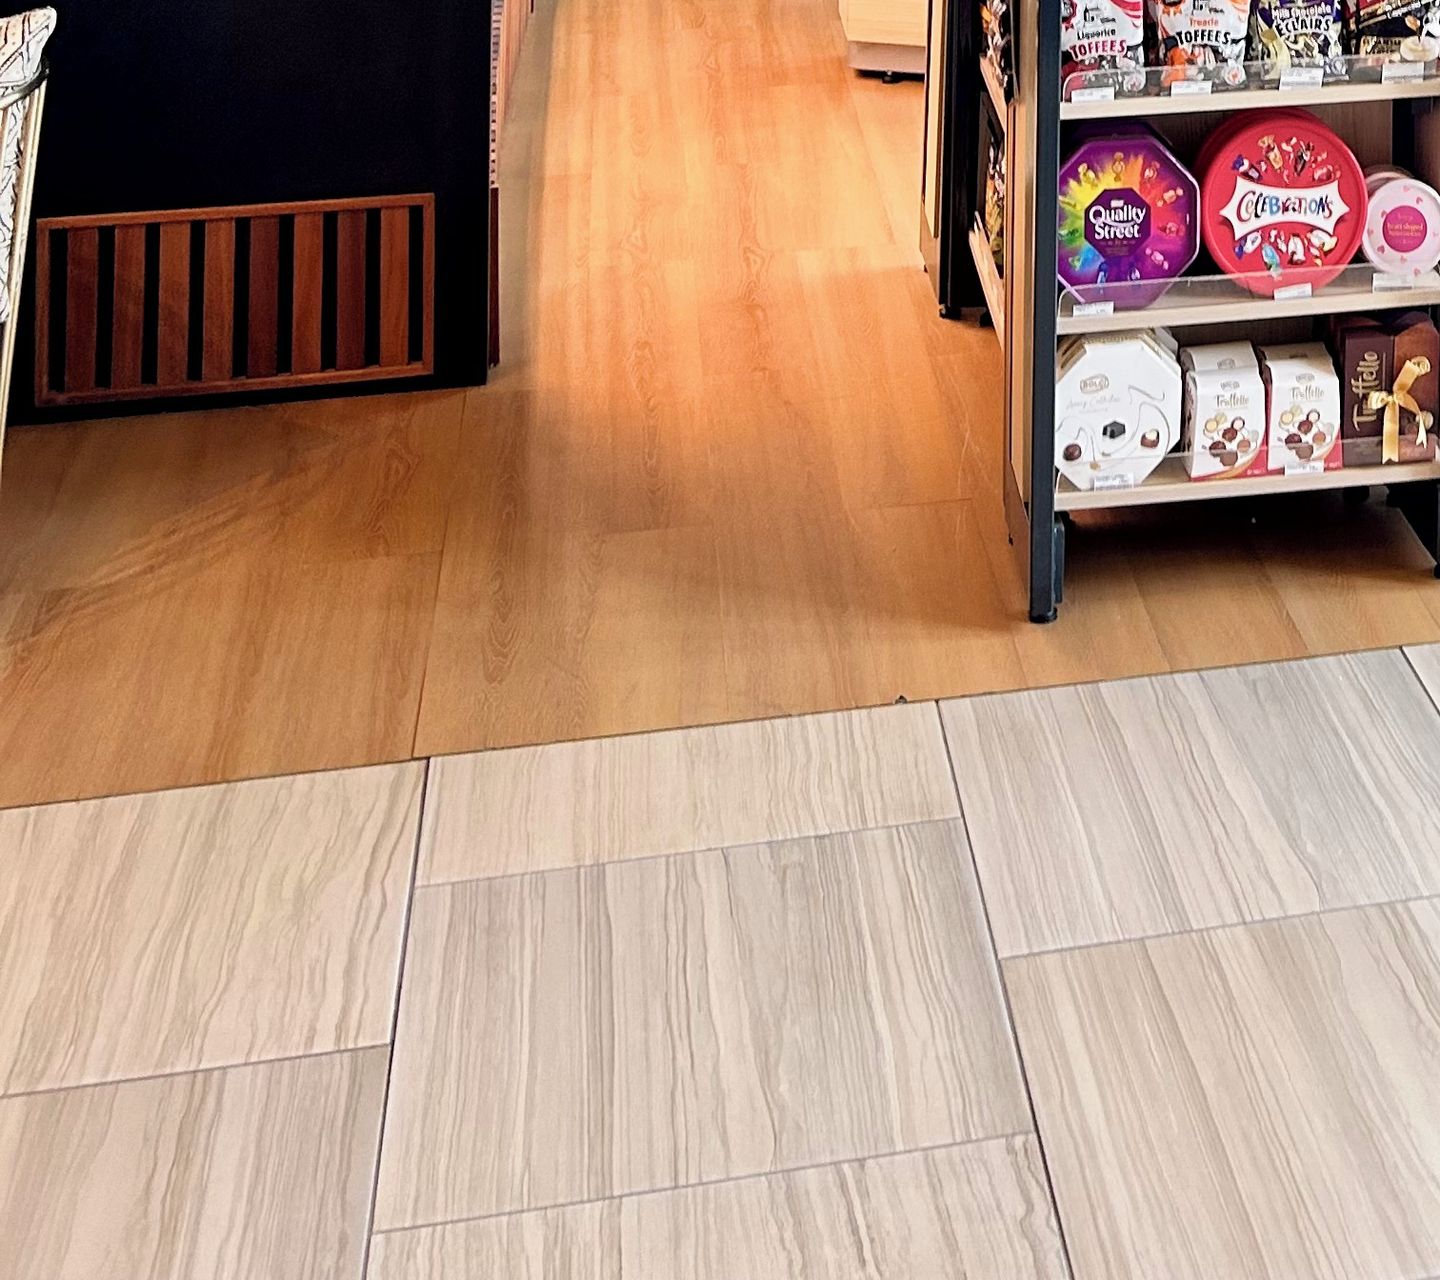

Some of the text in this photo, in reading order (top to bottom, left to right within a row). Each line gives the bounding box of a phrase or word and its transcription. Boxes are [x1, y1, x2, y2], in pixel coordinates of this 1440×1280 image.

[1291, 2, 1332, 19] Chocolate
[1076, 28, 1117, 41] Liquorice
[1175, 28, 1231, 46] TOFFEES
[1069, 39, 1128, 61] TOFFEES
[1089, 204, 1147, 225] Quality
[1094, 221, 1142, 240] Street
